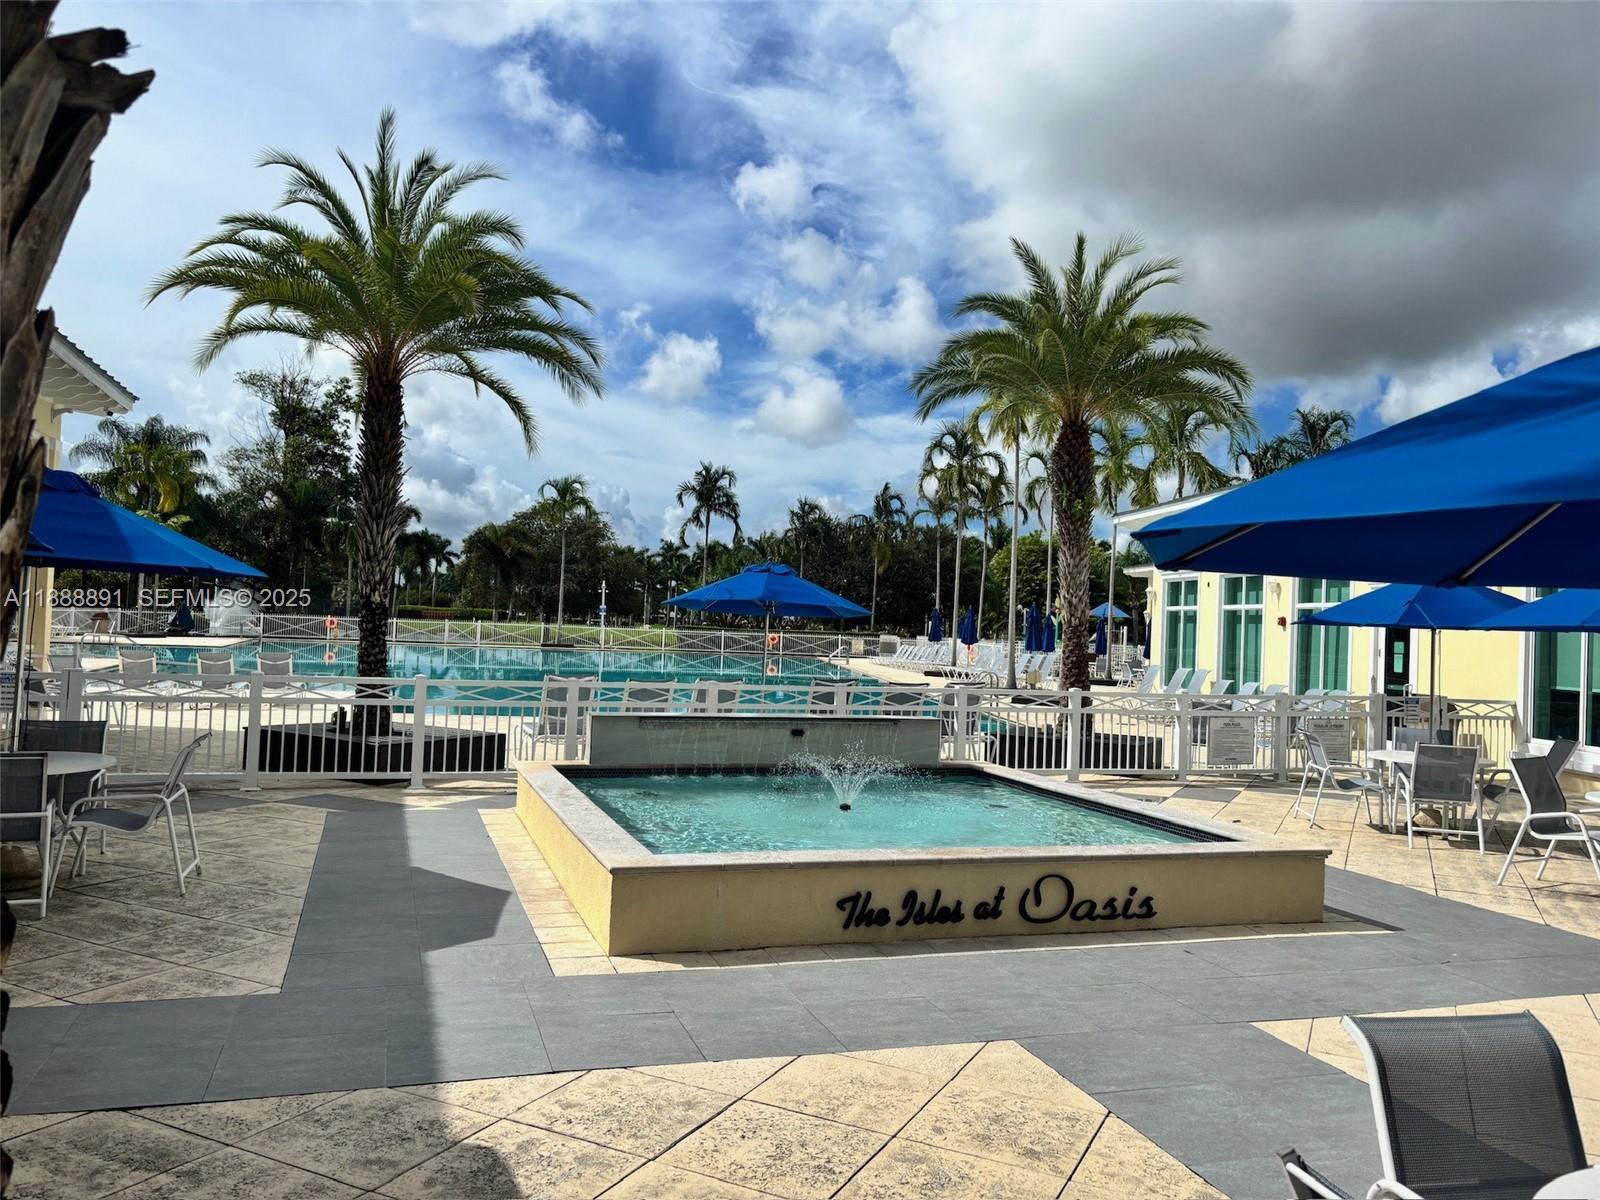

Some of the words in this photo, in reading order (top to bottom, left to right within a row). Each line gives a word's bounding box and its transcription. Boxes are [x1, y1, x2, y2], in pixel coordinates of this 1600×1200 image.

[836, 891, 891, 930] The
[896, 888, 965, 927] Isles
[973, 886, 1006, 921] at
[1018, 873, 1158, 924] Oasis
